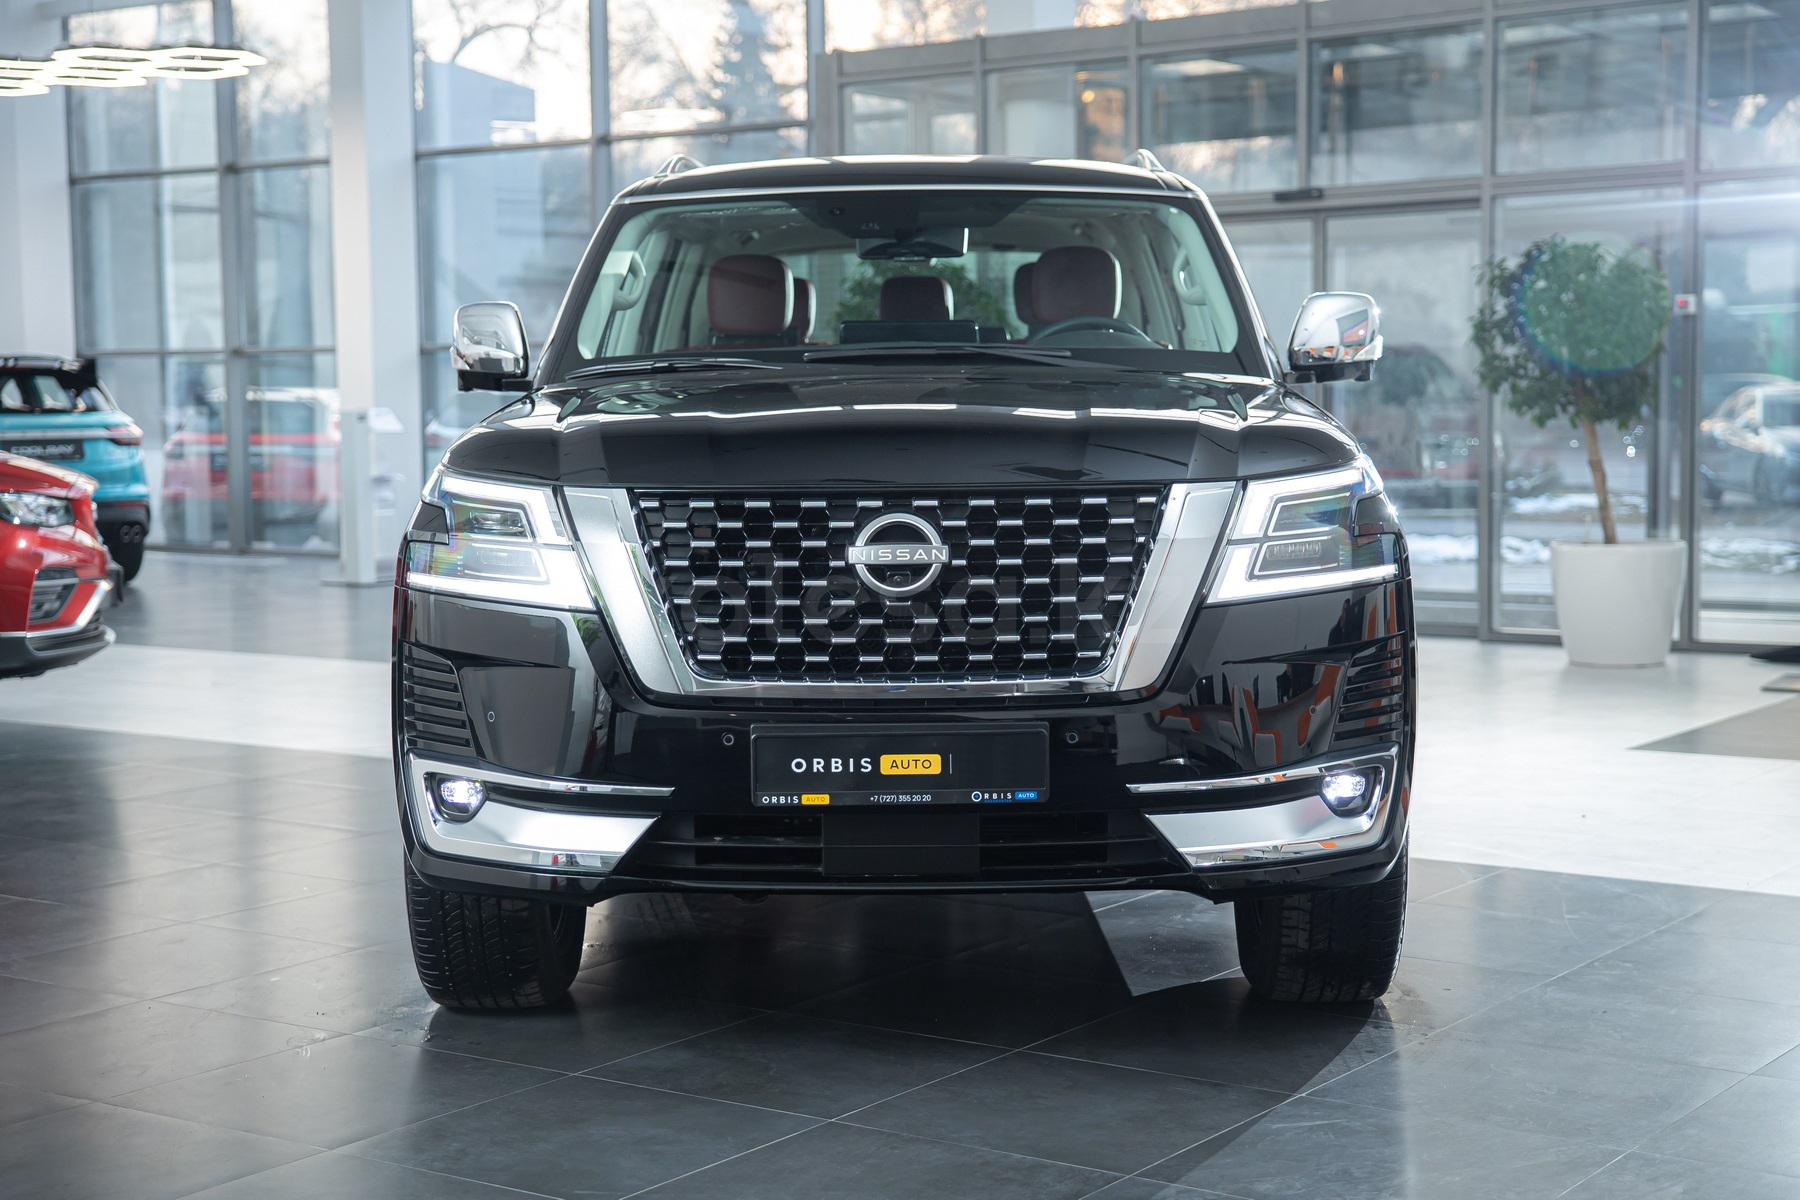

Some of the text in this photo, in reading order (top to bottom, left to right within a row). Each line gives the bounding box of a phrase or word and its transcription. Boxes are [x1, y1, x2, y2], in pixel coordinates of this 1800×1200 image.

[852, 549, 946, 561] NISSAN
[791, 758, 932, 773] ORBIS AUTO
[762, 795, 799, 804] ORBIS
[879, 794, 897, 803] (727)
[898, 794, 912, 802] 355
[912, 794, 922, 802] 20
[922, 794, 932, 802] 20
[971, 791, 1012, 802] ORBIS
